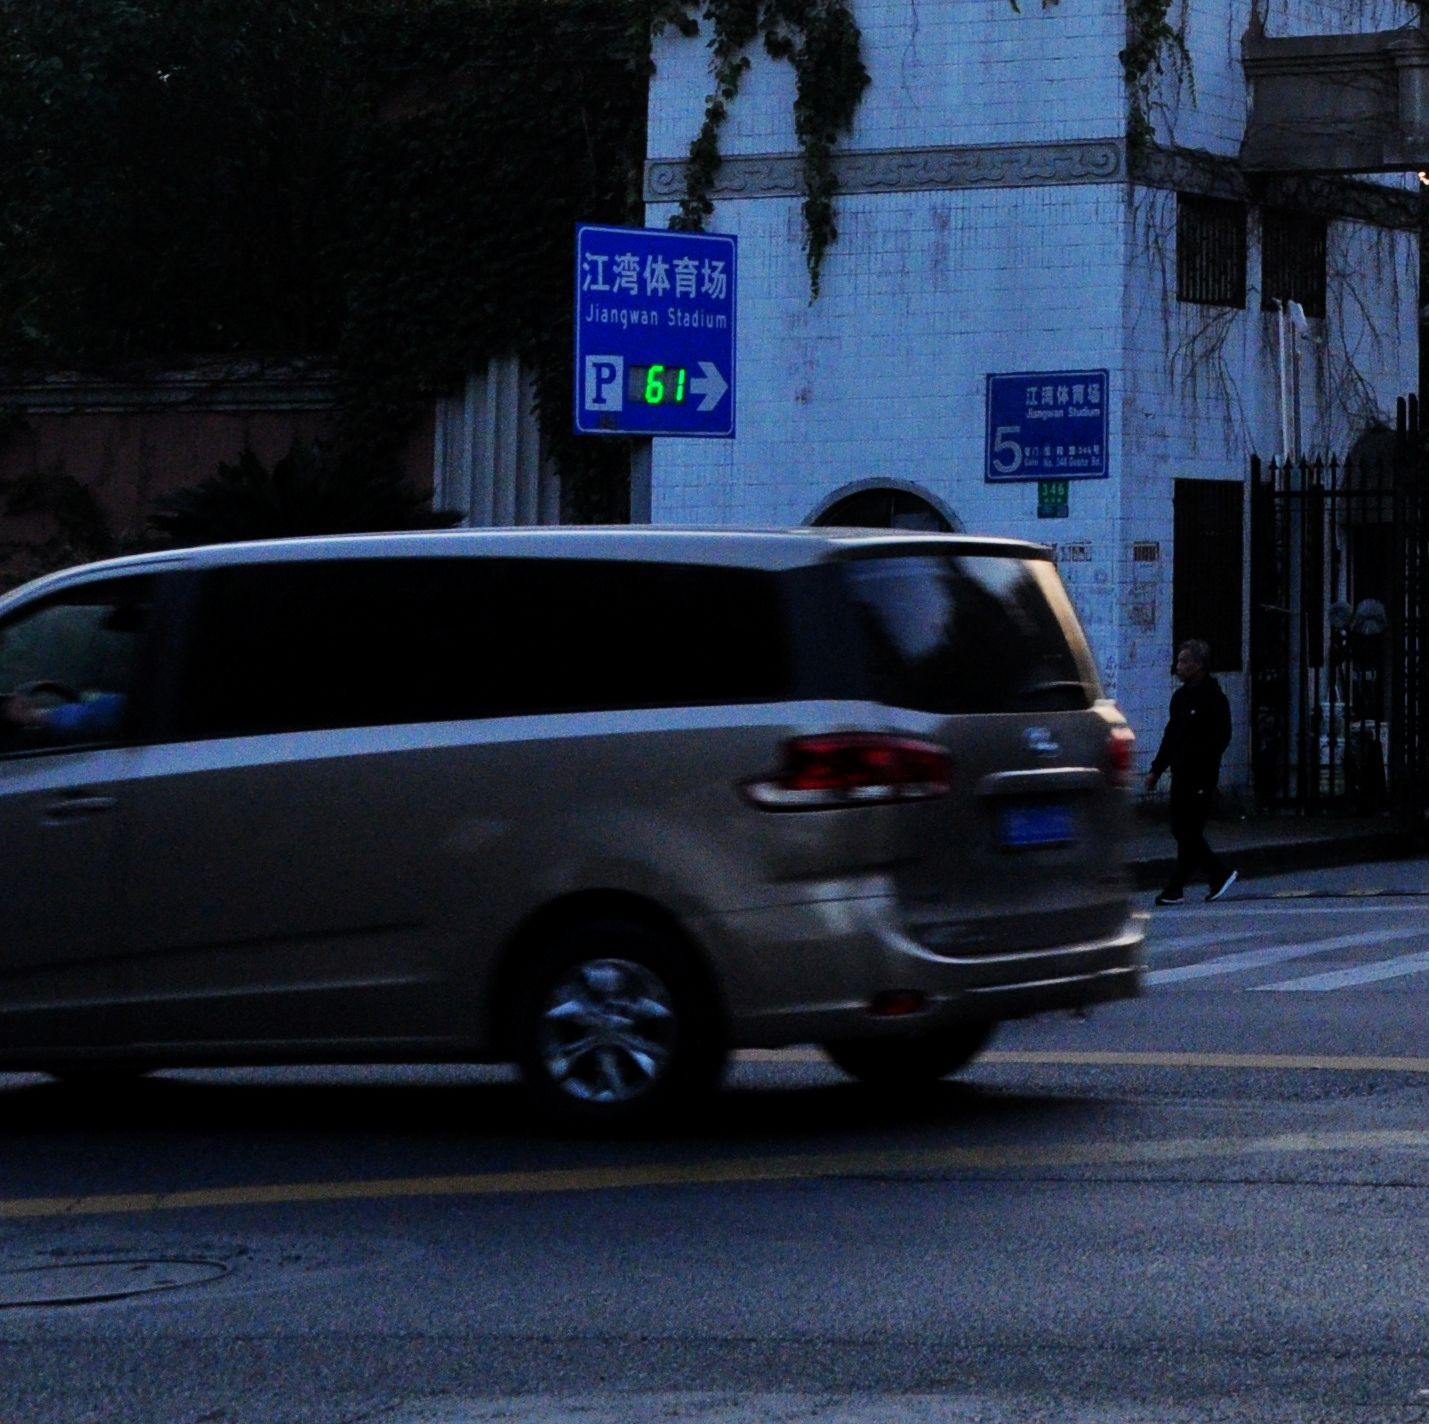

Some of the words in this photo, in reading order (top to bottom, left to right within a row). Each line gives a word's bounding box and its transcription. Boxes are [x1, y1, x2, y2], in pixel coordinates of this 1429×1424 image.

[582, 252, 727, 300] 江湾体育场
[586, 304, 658, 330] Jiangwan
[668, 307, 727, 329] Stadium
[591, 362, 617, 405] P
[644, 364, 686, 404] 61
[1026, 383, 1100, 406] 江湾体育场
[992, 426, 1023, 473] 5
